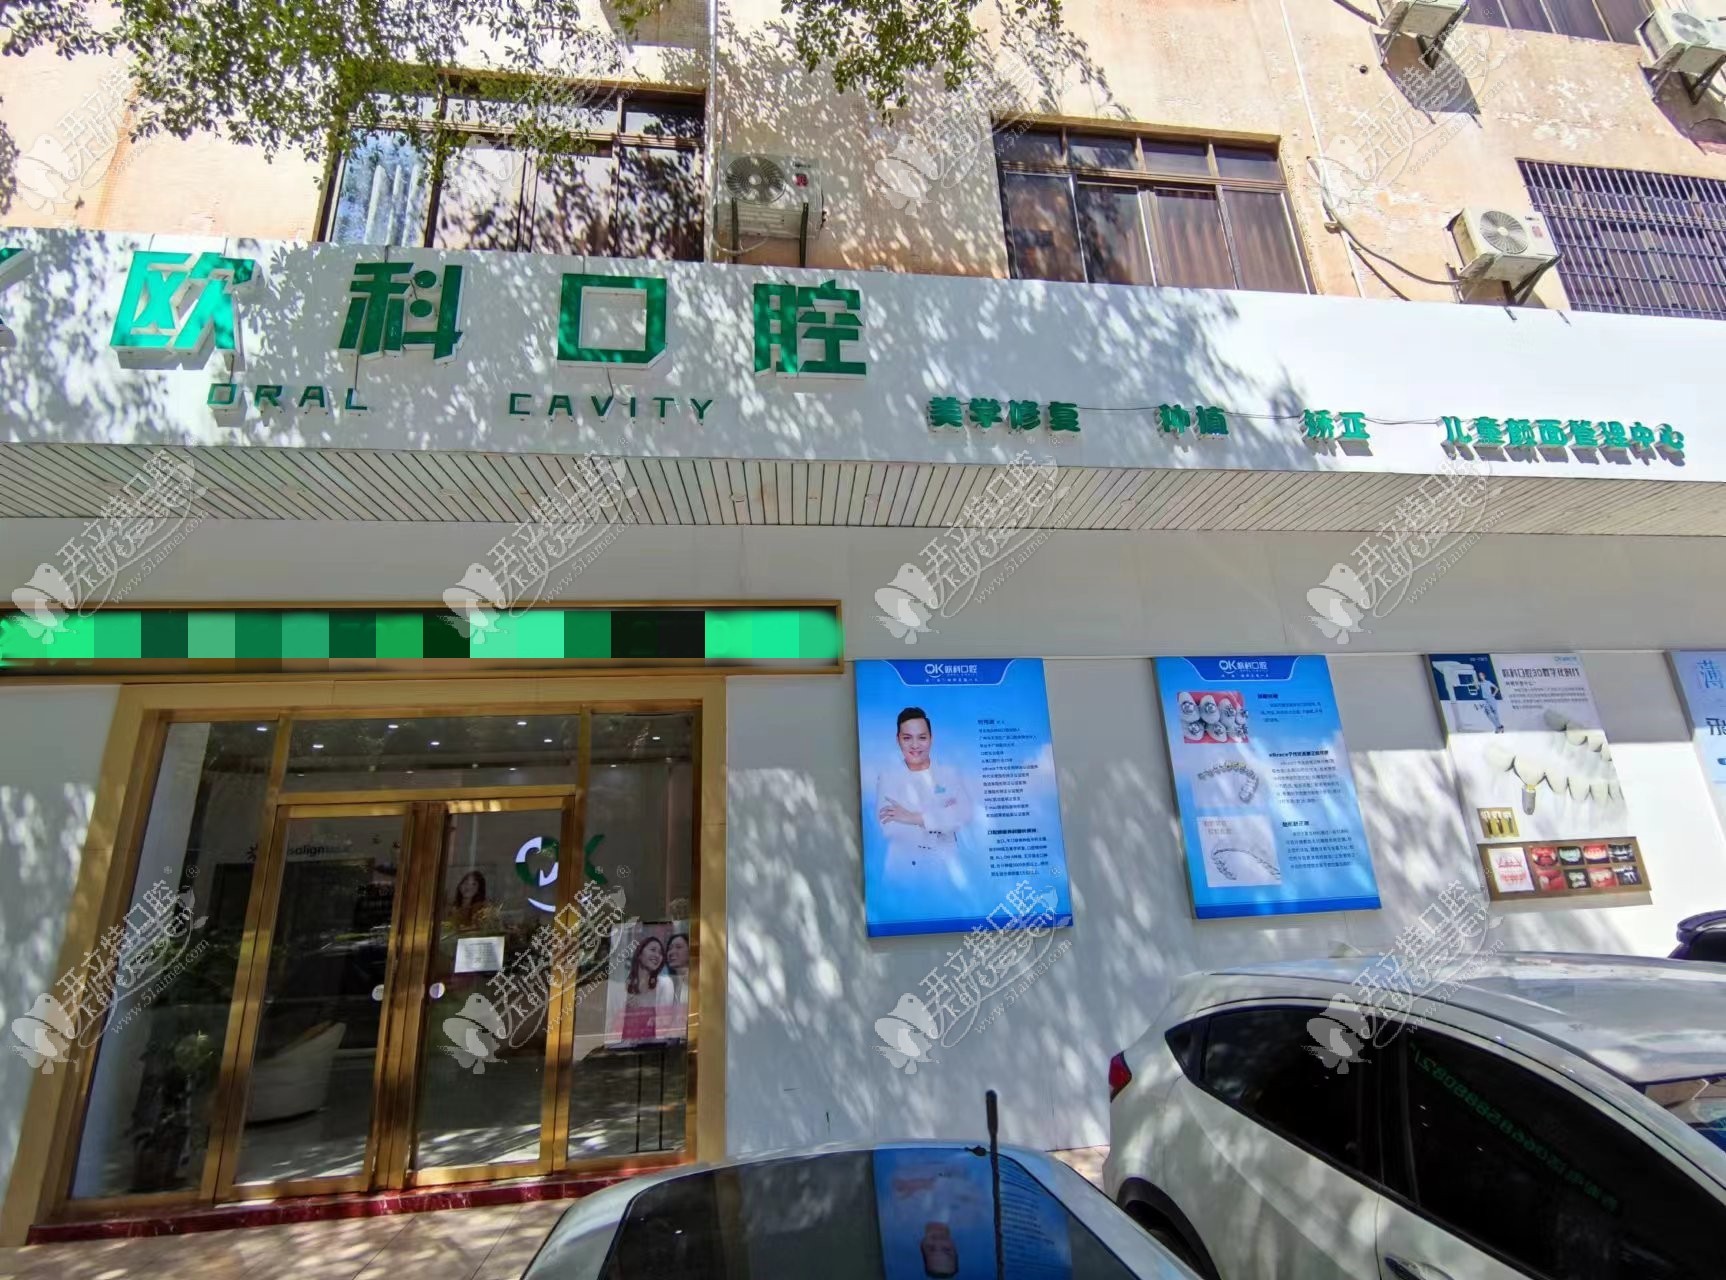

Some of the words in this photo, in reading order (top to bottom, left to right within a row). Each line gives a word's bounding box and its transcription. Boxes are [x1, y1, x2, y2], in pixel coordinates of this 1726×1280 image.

[110, 251, 867, 376] 欧科口腔
[207, 384, 368, 410] ORAL
[509, 393, 715, 420] CAVITY
[1157, 404, 1230, 437] 种植
[1302, 409, 1370, 440] 矫正
